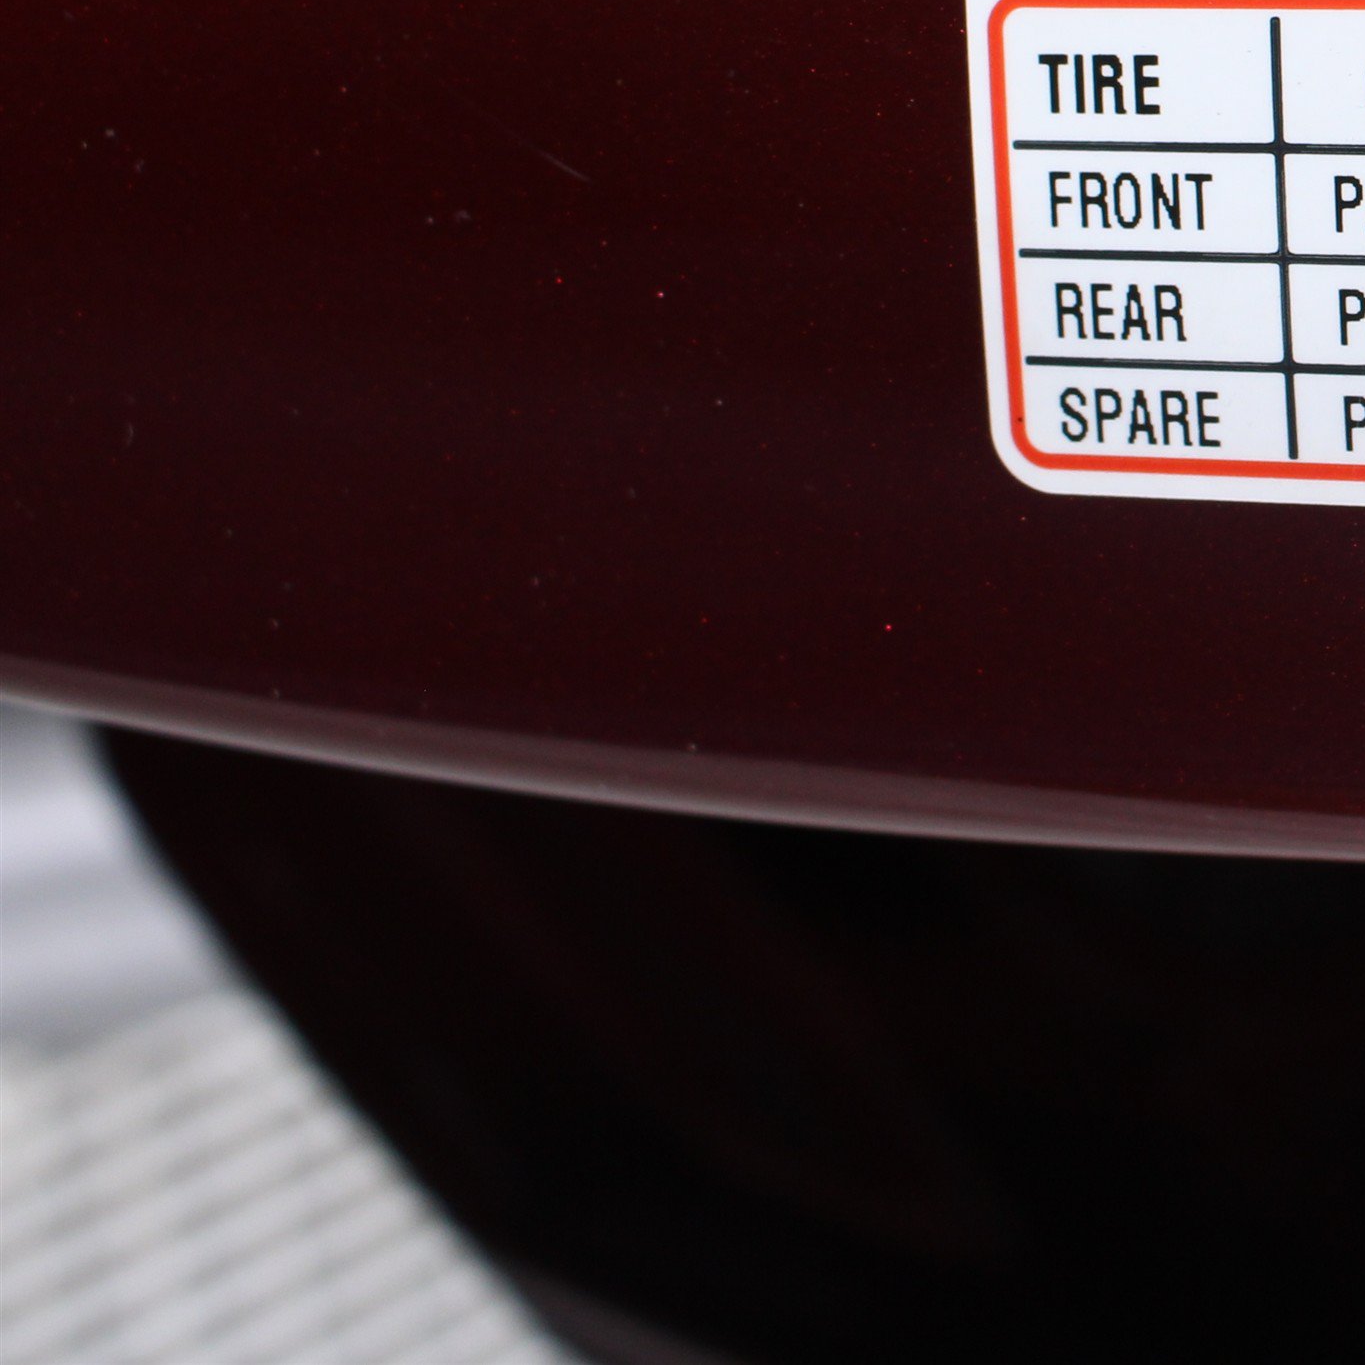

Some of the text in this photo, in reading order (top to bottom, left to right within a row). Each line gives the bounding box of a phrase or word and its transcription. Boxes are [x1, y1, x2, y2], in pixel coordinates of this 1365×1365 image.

[1039, 55, 1159, 114] TIRE
[1050, 172, 1212, 229] FRONT
[1056, 283, 1186, 341] REAR
[1061, 388, 1220, 446] SPARE
